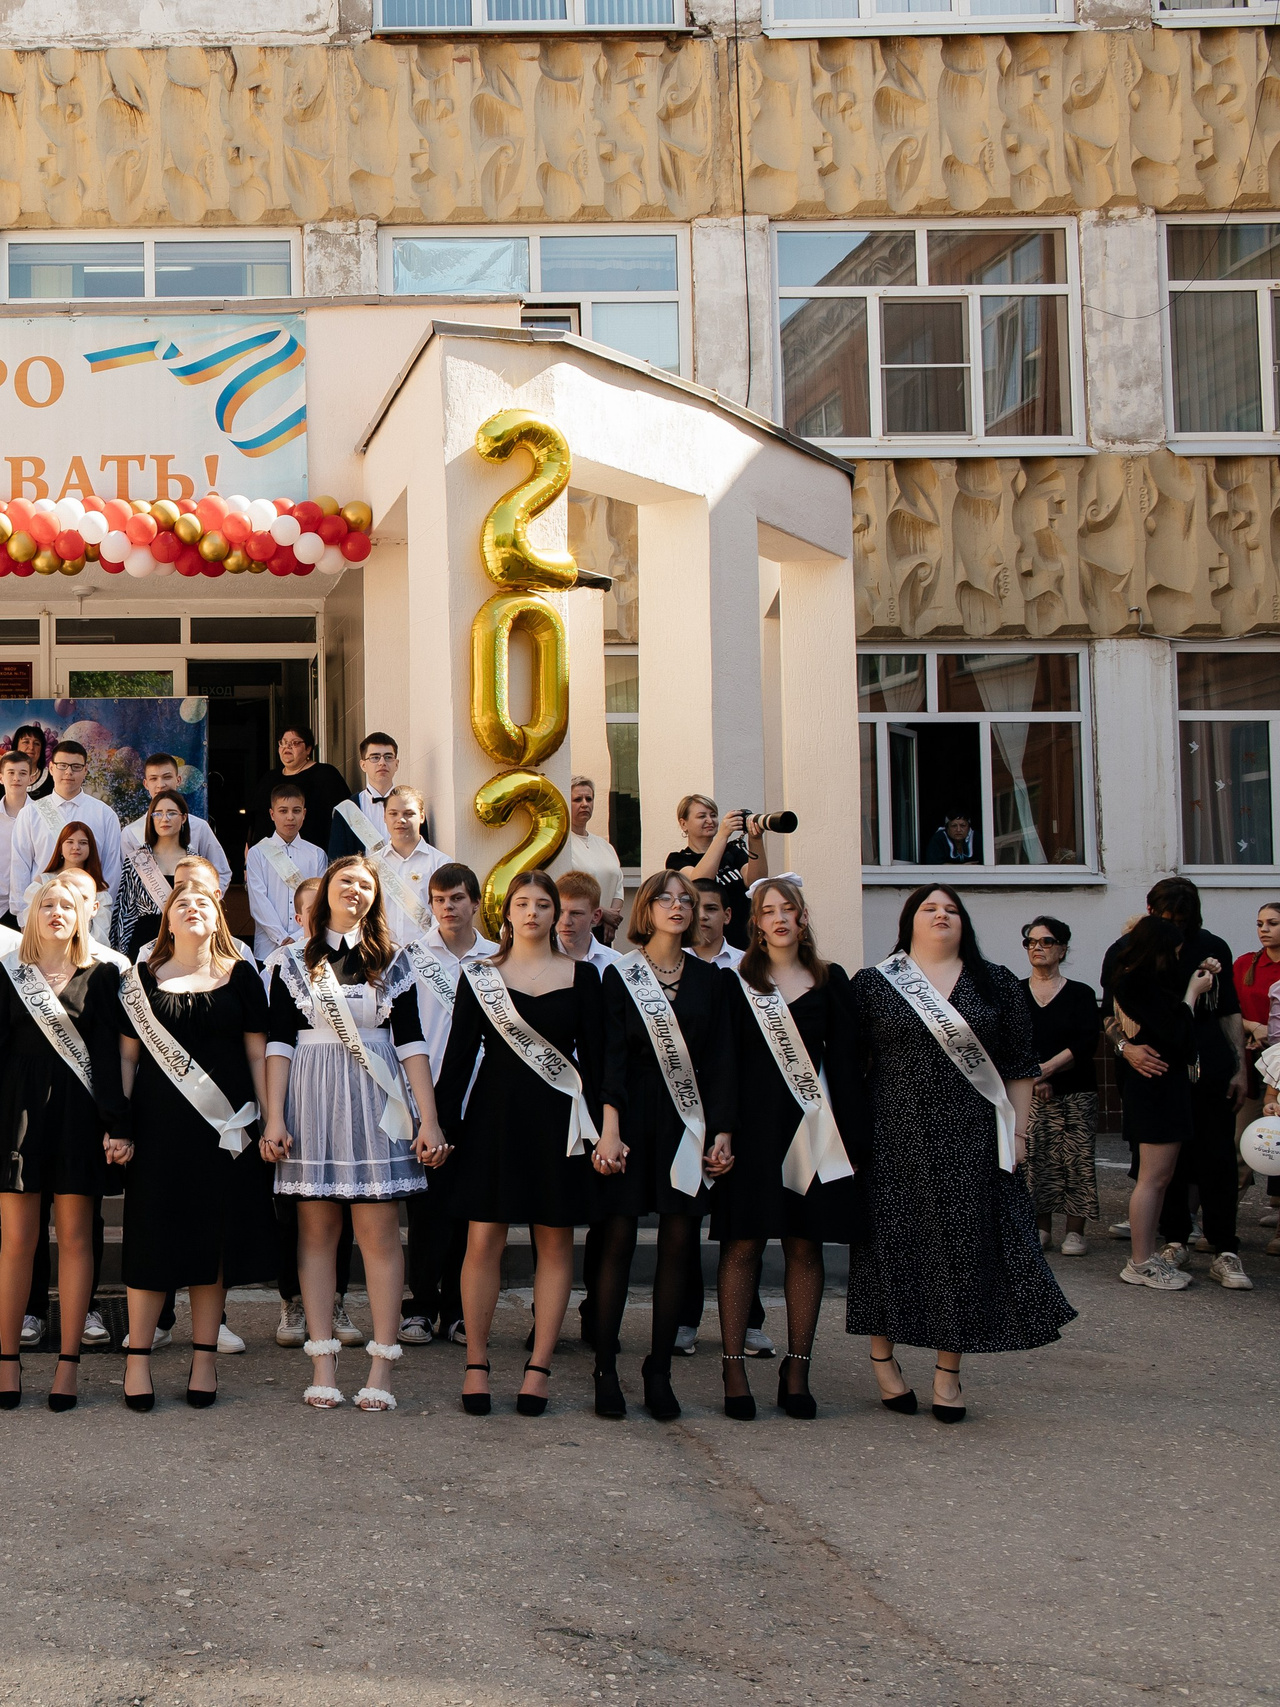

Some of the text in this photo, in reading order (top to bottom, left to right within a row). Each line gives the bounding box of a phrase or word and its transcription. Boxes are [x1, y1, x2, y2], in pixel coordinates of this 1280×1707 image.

[201, 686, 233, 696] ВХОД
[21, 982, 82, 1062] Выпускница
[121, 980, 170, 1057] Выпускница
[474, 978, 568, 1076] Выпускник 2025
[634, 988, 699, 1108] Выпускник 2025
[747, 986, 822, 1102] Выпускник 2025
[895, 972, 986, 1069] Выпускник 2025
